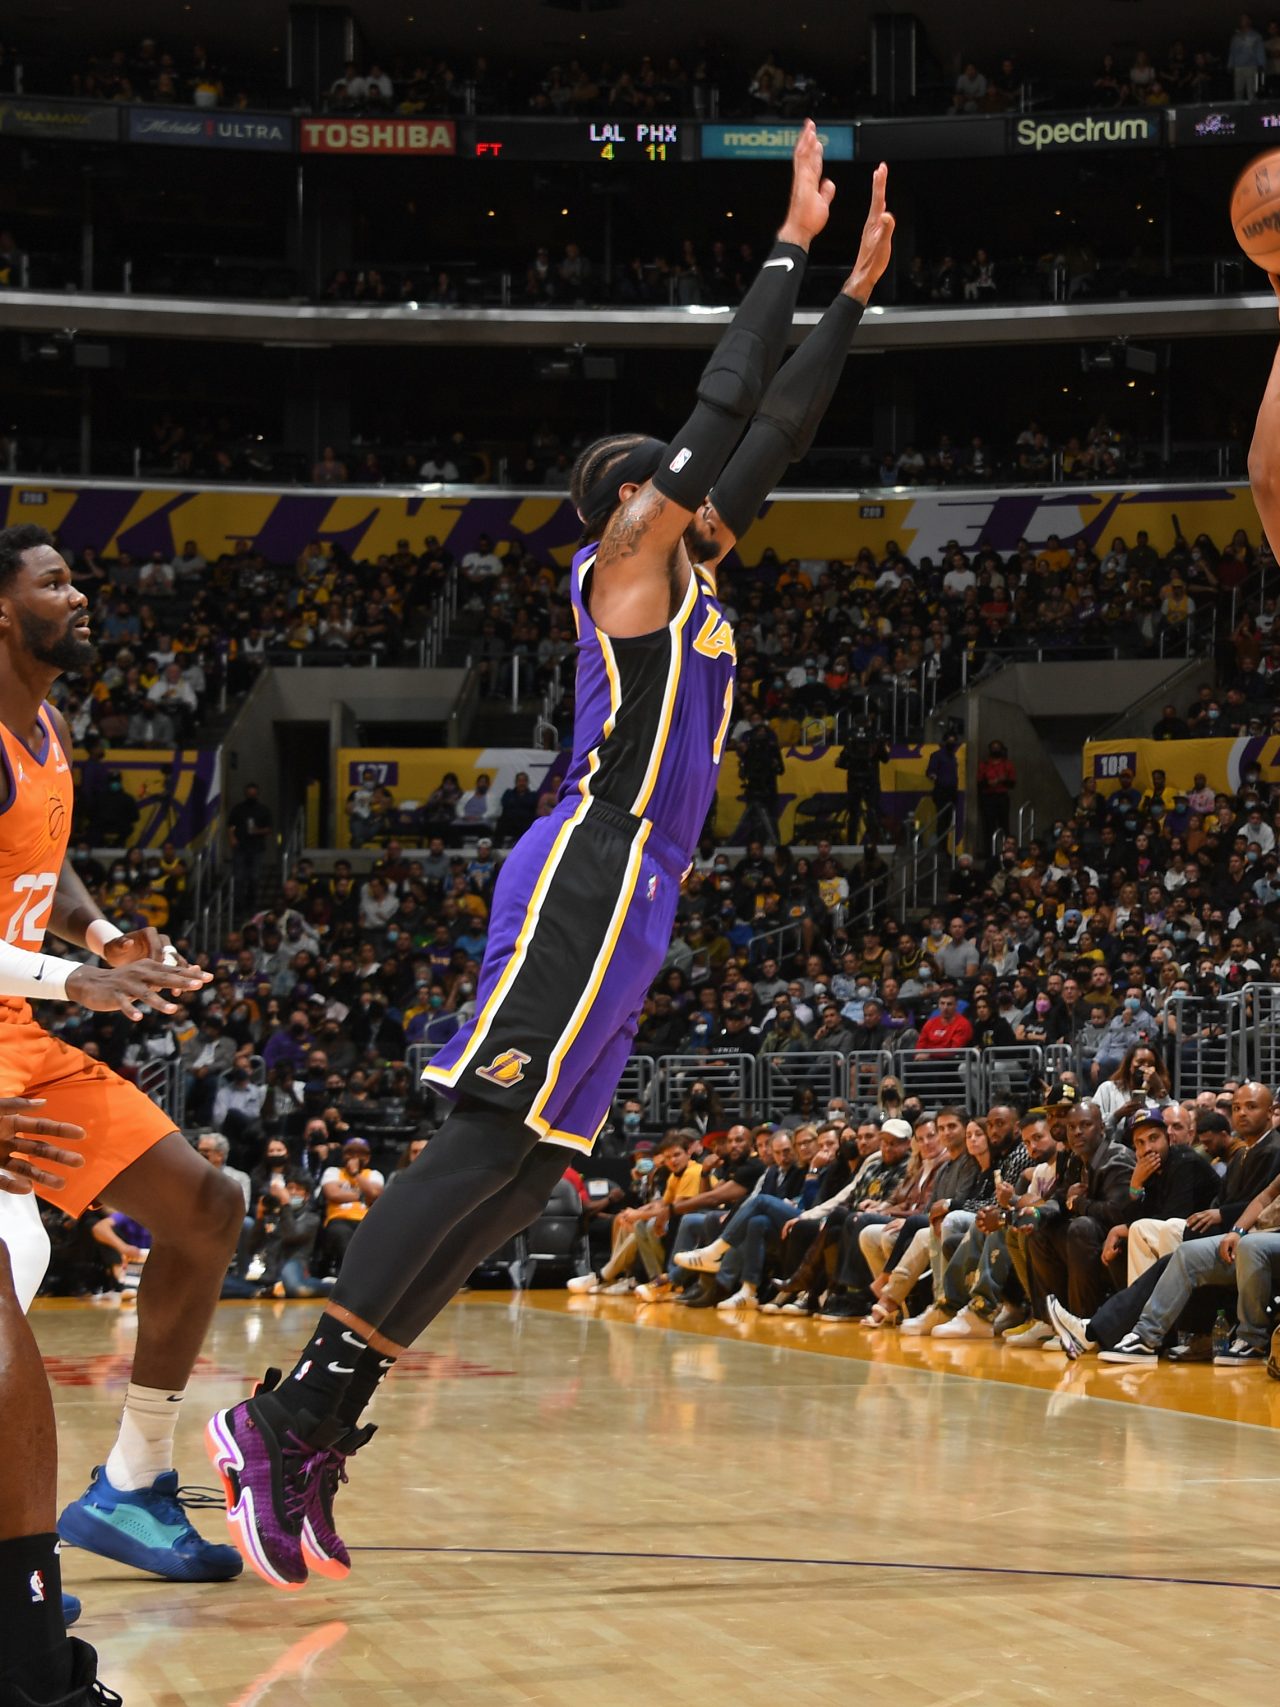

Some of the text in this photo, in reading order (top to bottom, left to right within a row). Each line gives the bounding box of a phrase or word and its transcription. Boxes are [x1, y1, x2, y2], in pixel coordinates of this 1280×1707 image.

[217, 123, 283, 140] ULTRA
[304, 123, 452, 149] TOSHIBA
[589, 124, 677, 143] LAL PHX
[1018, 117, 1148, 150] Spectrum
[475, 142, 503, 157] FT
[600, 142, 666, 161] 4 11
[5, 872, 58, 943] 22
